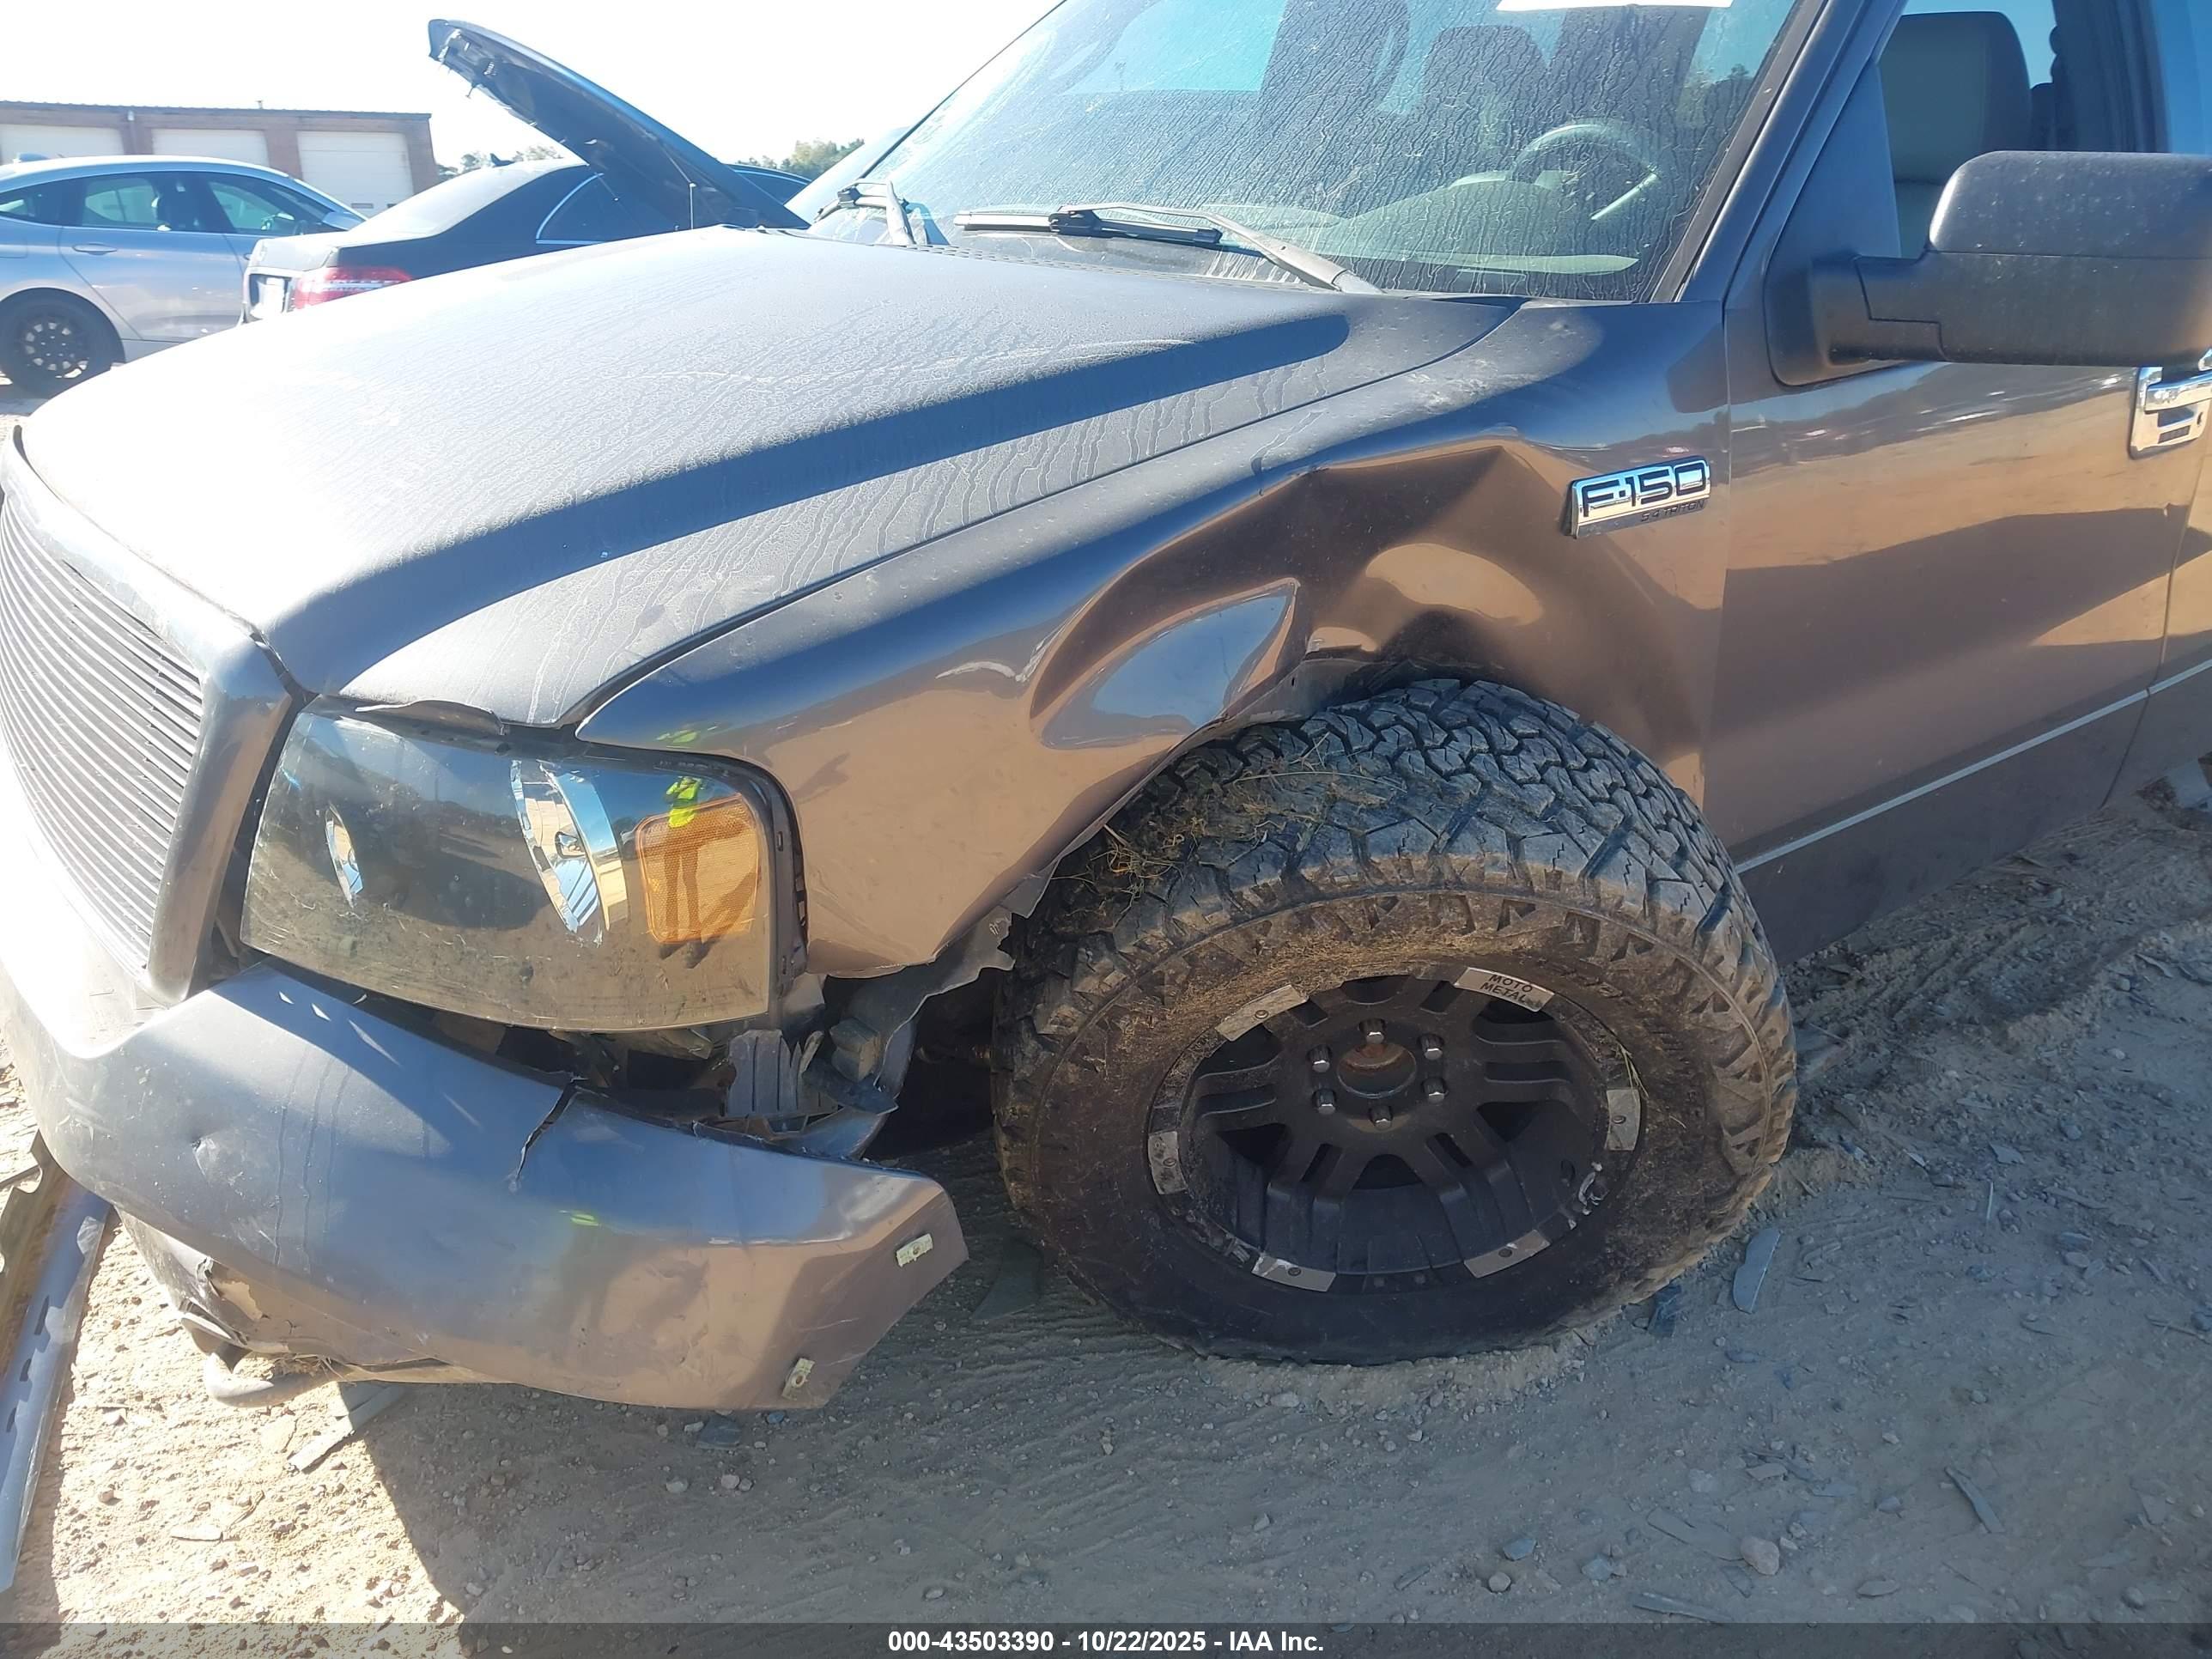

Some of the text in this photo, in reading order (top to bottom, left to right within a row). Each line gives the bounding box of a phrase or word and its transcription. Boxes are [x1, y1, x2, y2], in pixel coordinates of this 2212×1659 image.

[1581, 461, 1706, 518] F-150
[1663, 500, 1705, 516] TRITON
[1480, 982, 1527, 1003] METAL
[1488, 974, 1533, 993] MOTO
